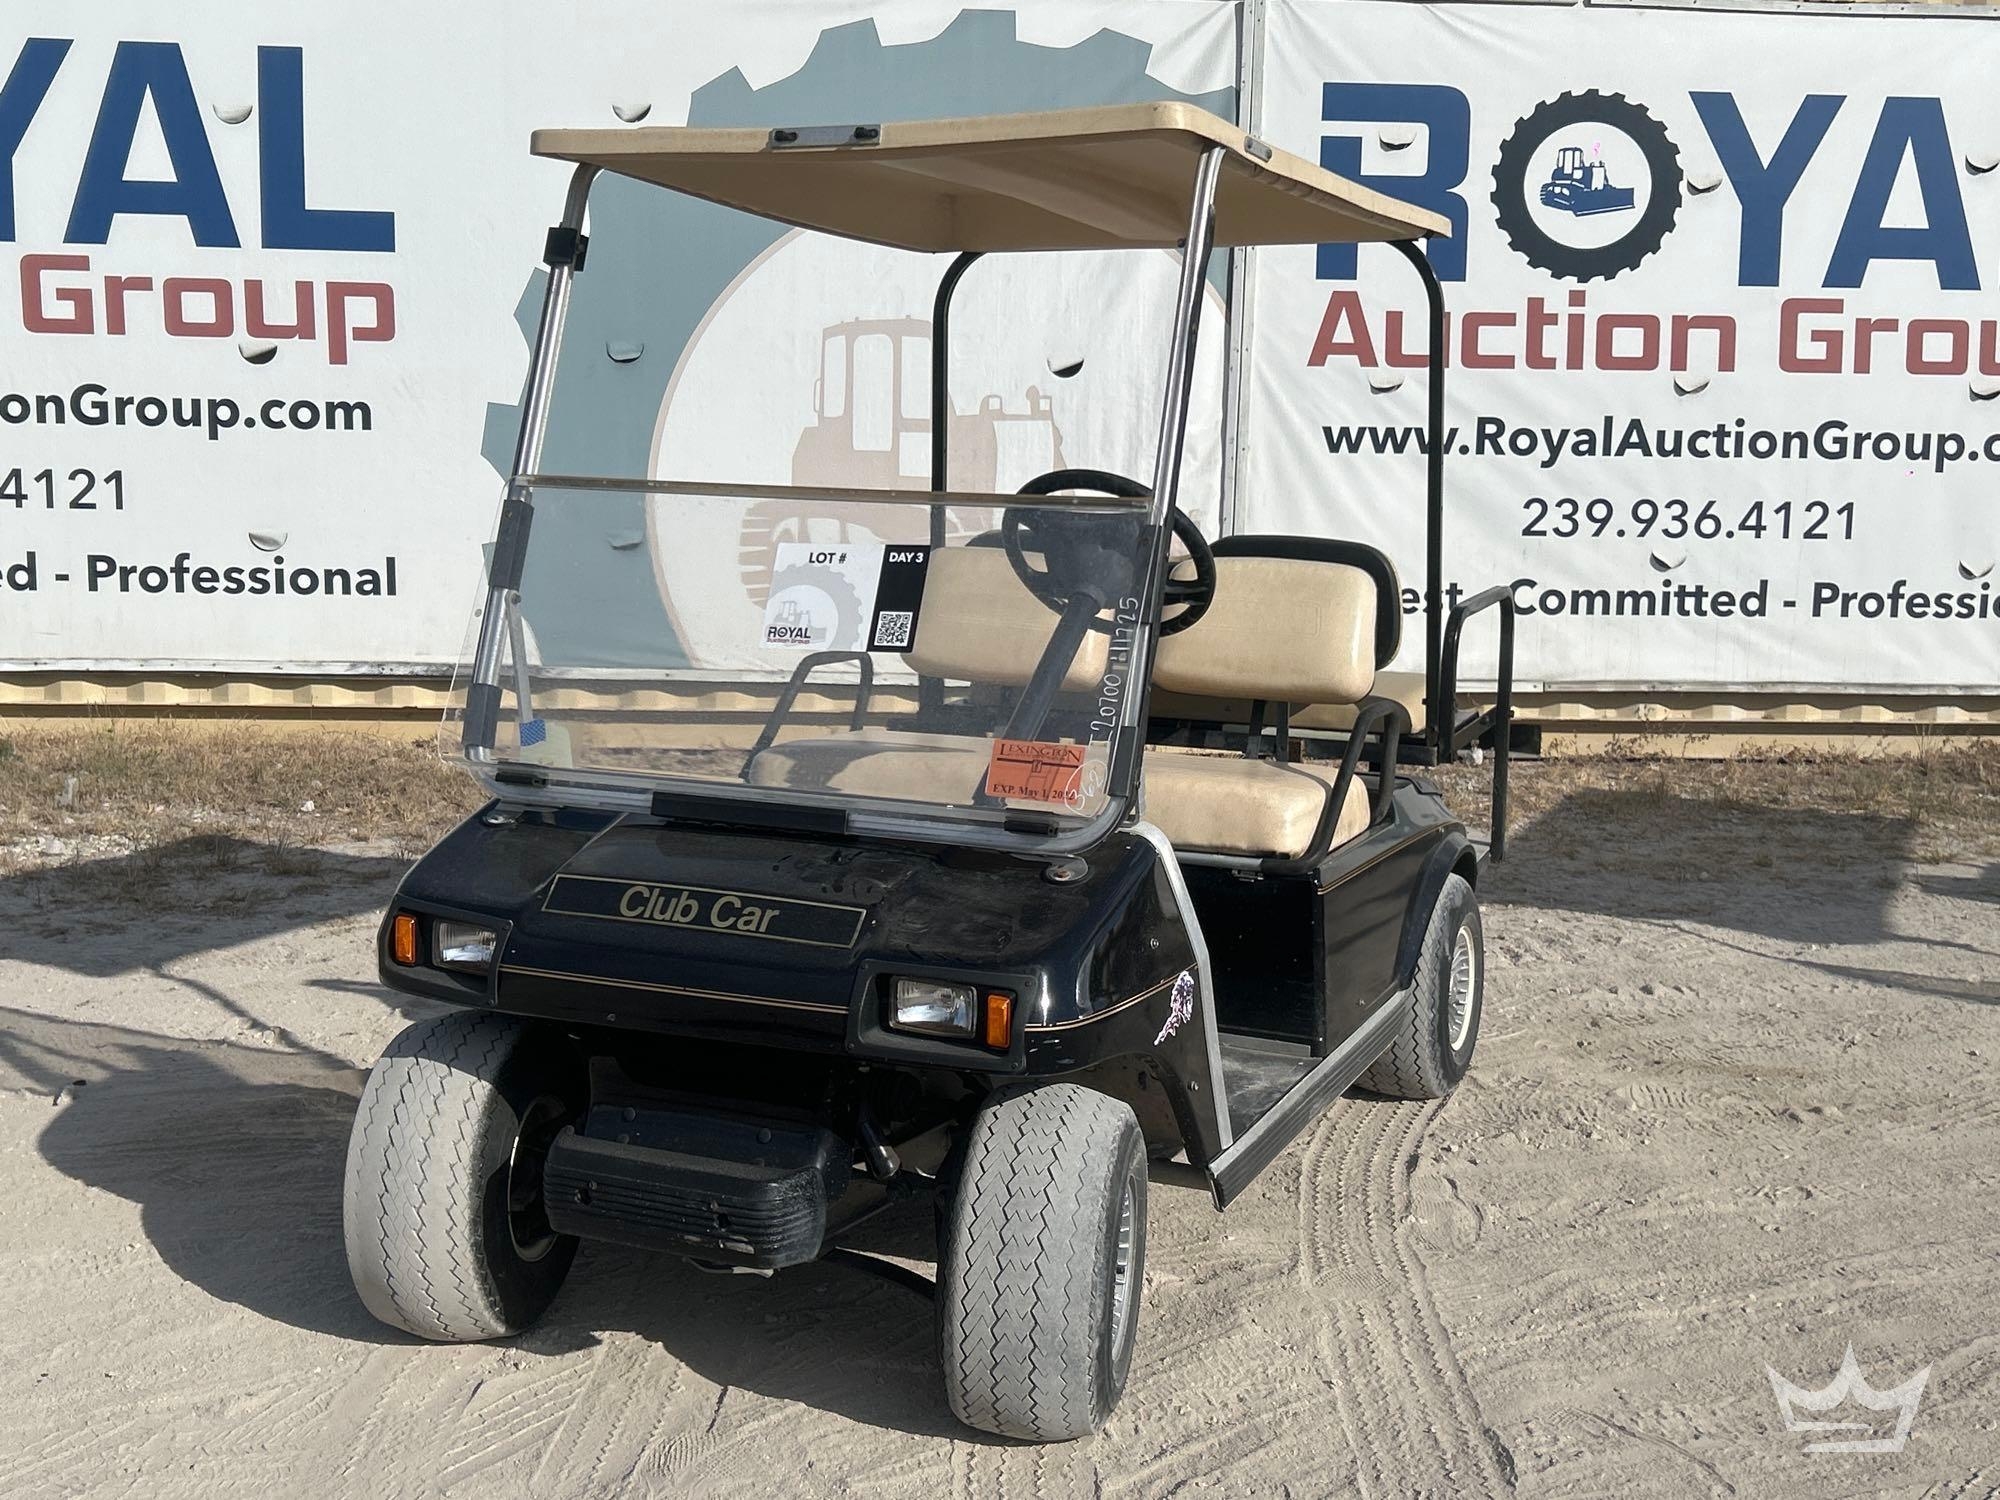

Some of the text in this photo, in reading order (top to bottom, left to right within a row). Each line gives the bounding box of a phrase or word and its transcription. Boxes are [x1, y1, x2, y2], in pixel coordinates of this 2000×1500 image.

[19, 254, 396, 365] Group
[1307, 290, 1737, 373] Auction
[0, 383, 373, 440] onGroup.com
[1521, 499, 1855, 540] 239.936.4121
[86, 552, 399, 597] Professional
[808, 552, 847, 564] LOT #
[888, 551, 924, 563] DAY 3
[1508, 577, 1769, 618] Committed
[1812, 579, 2000, 619] Professi
[767, 626, 812, 639] ROYAL
[993, 783, 1016, 795] EXP.
[1019, 785, 1039, 797] May
[619, 886, 780, 933] Club Car
